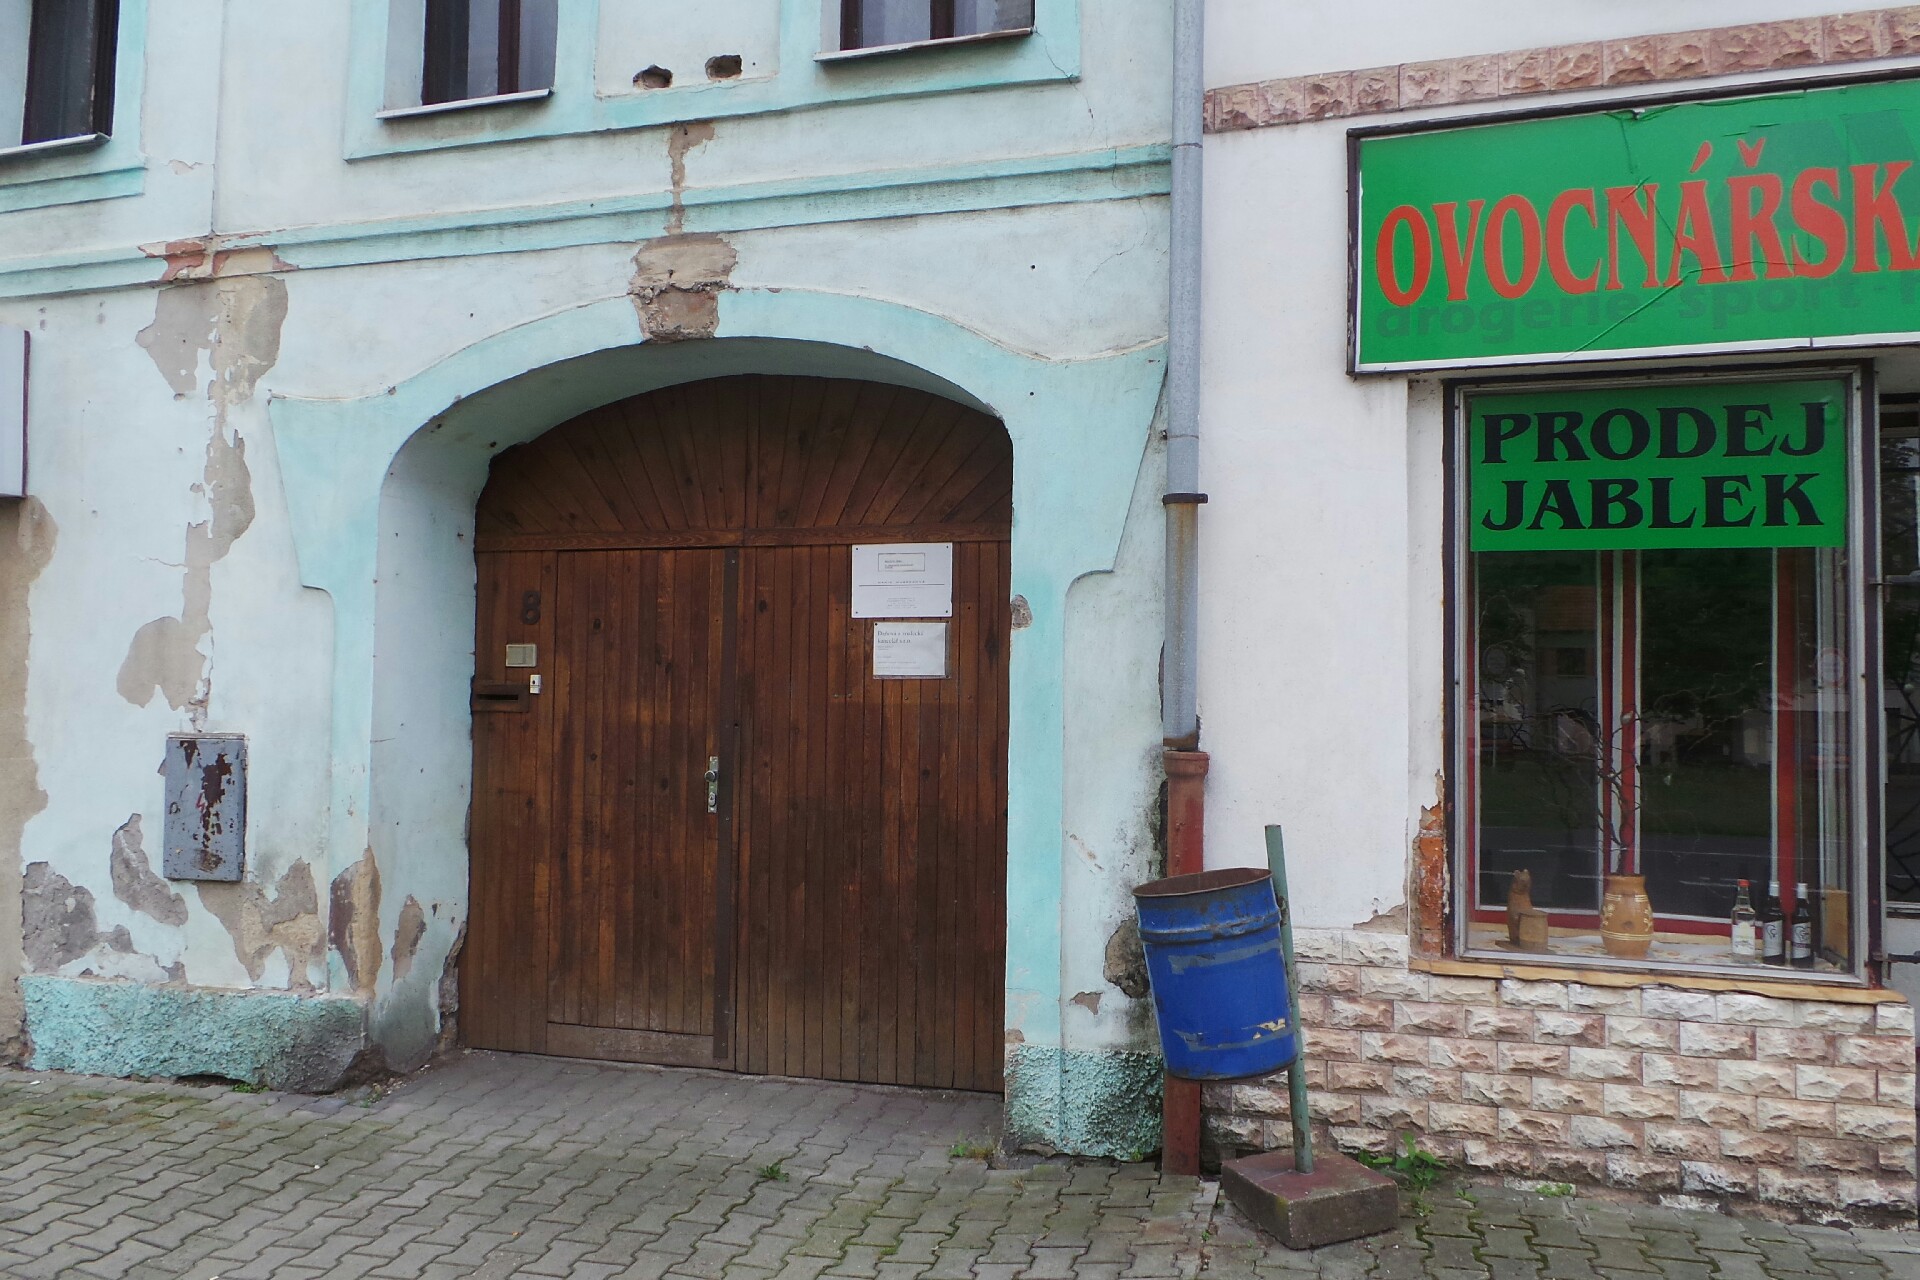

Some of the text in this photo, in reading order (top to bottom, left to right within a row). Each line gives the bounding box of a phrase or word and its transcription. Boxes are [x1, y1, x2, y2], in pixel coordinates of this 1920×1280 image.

[1376, 138, 1920, 306] OVOCNÁŘSK
[1481, 402, 1829, 464] PRODEJ
[1481, 473, 1825, 531] JABLEK
